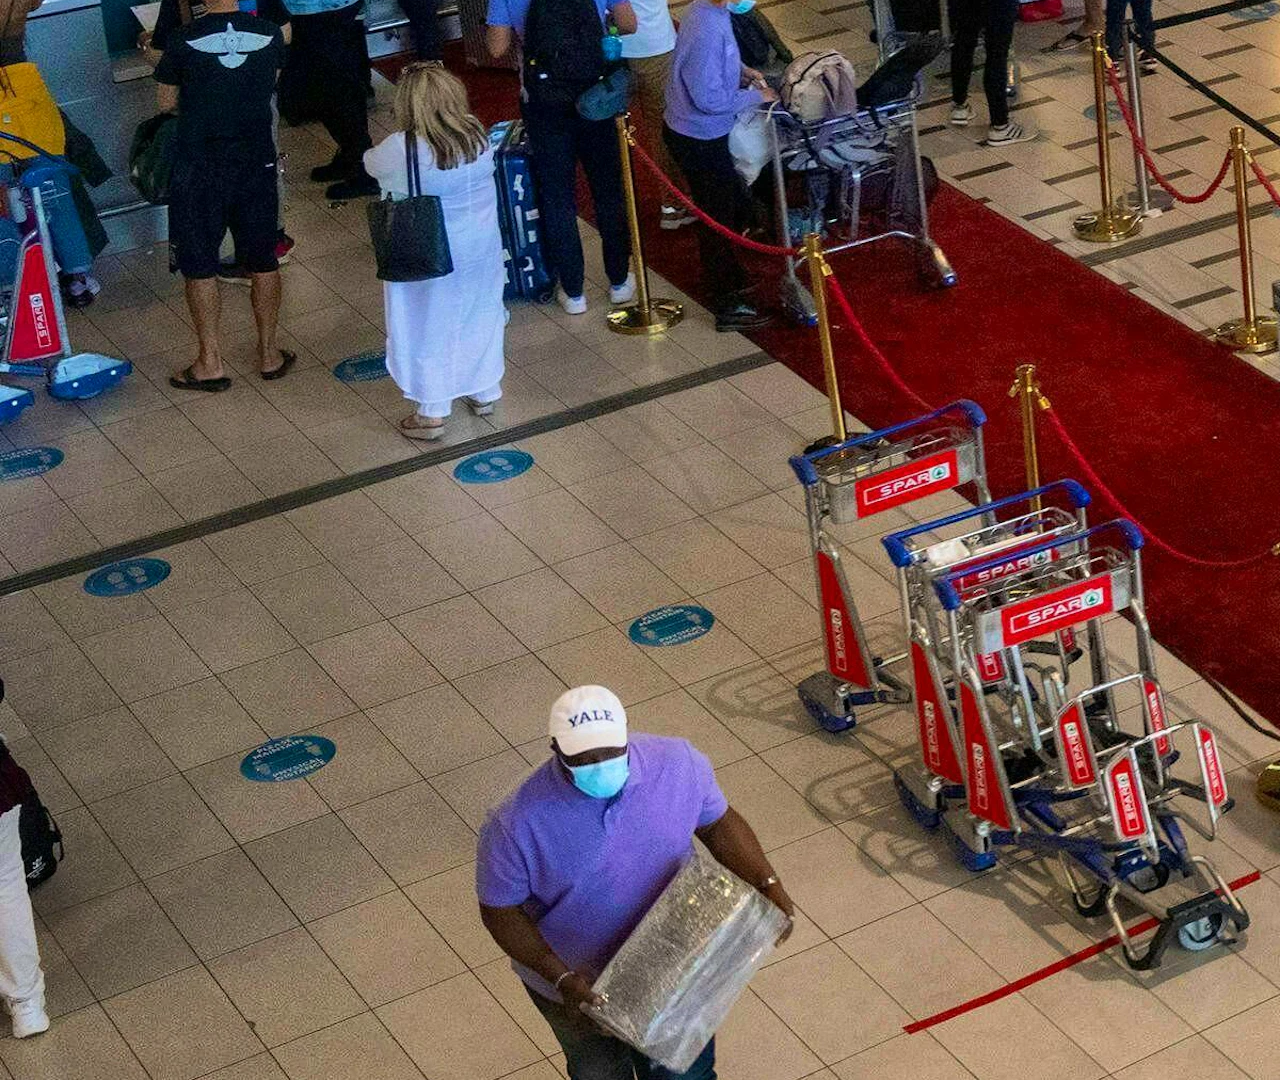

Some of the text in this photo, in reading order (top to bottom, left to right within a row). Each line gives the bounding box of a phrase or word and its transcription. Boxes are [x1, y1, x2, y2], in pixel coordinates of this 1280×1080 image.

[34, 306, 48, 338] SPAR
[880, 472, 930, 498] SPAR
[977, 559, 1032, 582] SPAR
[1027, 599, 1082, 626] SPAR
[831, 620, 846, 660] SPAR
[567, 709, 615, 729] YALE
[1067, 733, 1085, 770] SPAR
[973, 756, 988, 804] SPAR
[1118, 786, 1137, 824] SPAR
